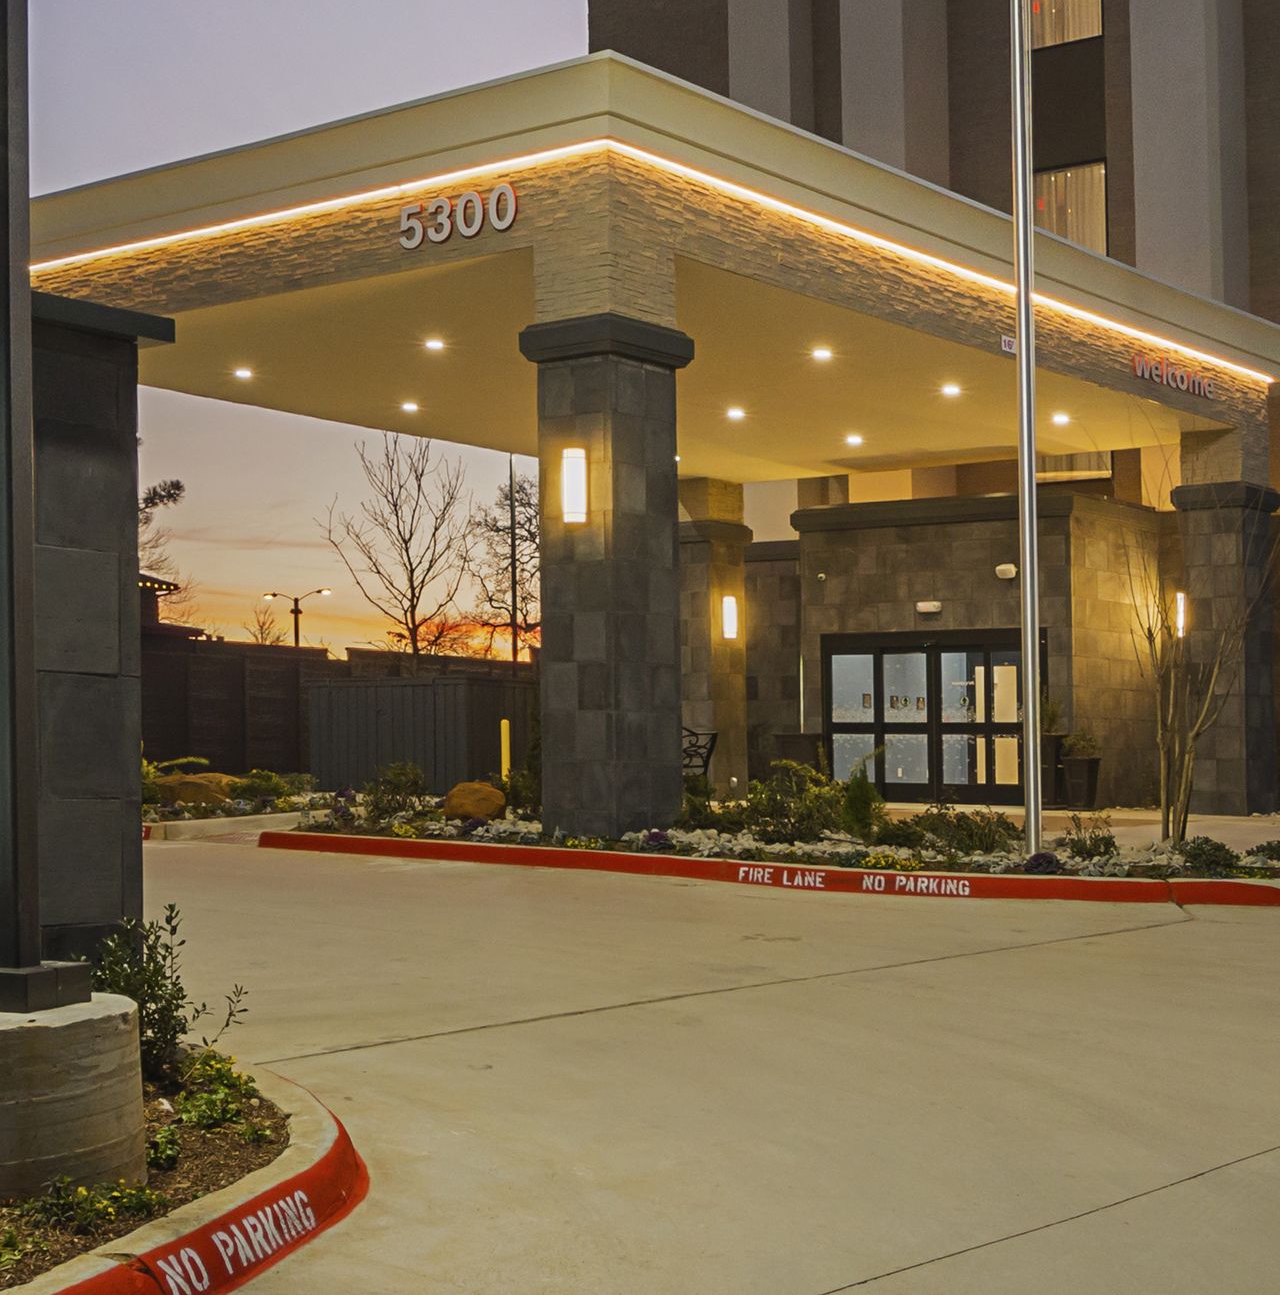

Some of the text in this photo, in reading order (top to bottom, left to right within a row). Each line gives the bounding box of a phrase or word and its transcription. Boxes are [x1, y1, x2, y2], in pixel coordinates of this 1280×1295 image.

[399, 183, 517, 250] 5300
[1132, 353, 1216, 400] Welcome
[738, 866, 971, 896] FIRE LANE NO PARKING
[156, 1189, 317, 1295] NO PARKING
